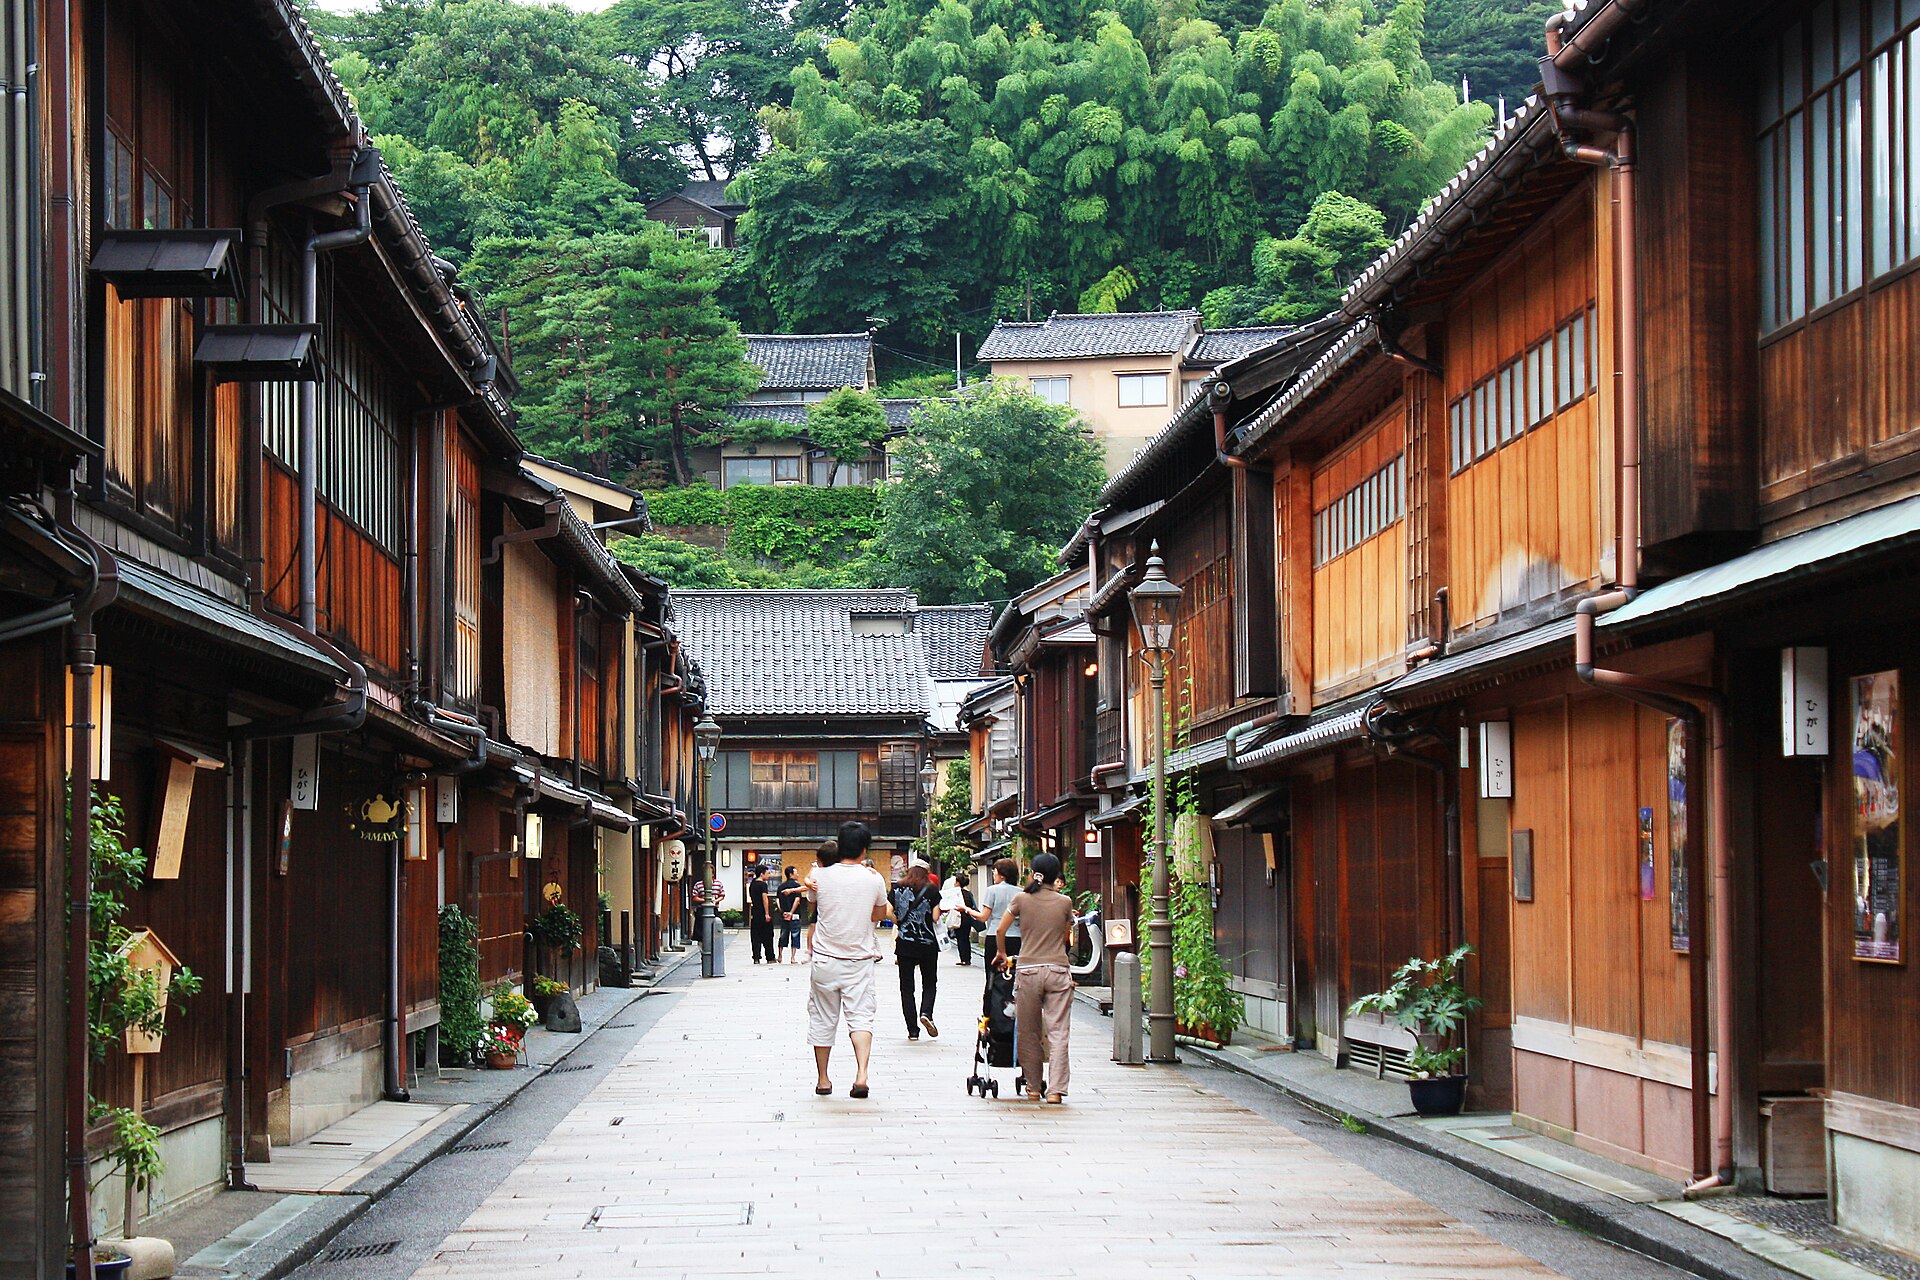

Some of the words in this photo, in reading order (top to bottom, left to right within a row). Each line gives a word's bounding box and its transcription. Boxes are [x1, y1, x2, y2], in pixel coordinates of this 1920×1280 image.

[1806, 699, 1818, 746] ひがし
[296, 768, 308, 801] ひがし
[1495, 758, 1504, 790] ひがし
[360, 830, 399, 842] YAMAYA
